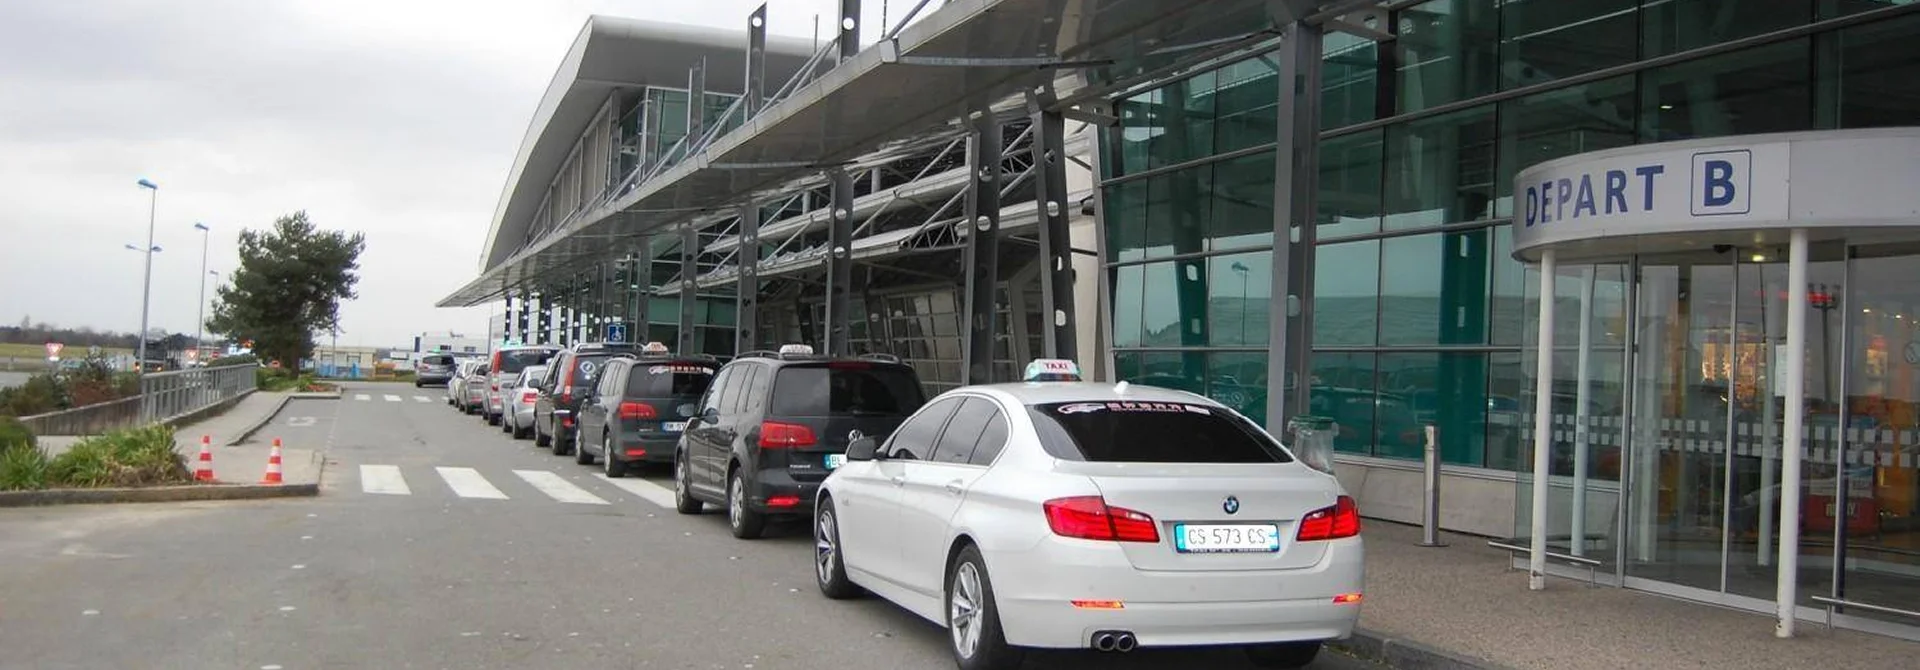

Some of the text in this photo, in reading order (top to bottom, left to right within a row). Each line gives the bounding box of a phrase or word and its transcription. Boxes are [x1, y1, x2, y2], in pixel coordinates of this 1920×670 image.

[1526, 159, 1735, 228] DEPART B
[1044, 362, 1069, 371] TAXI
[1188, 528, 1266, 545] CS 573 CS
